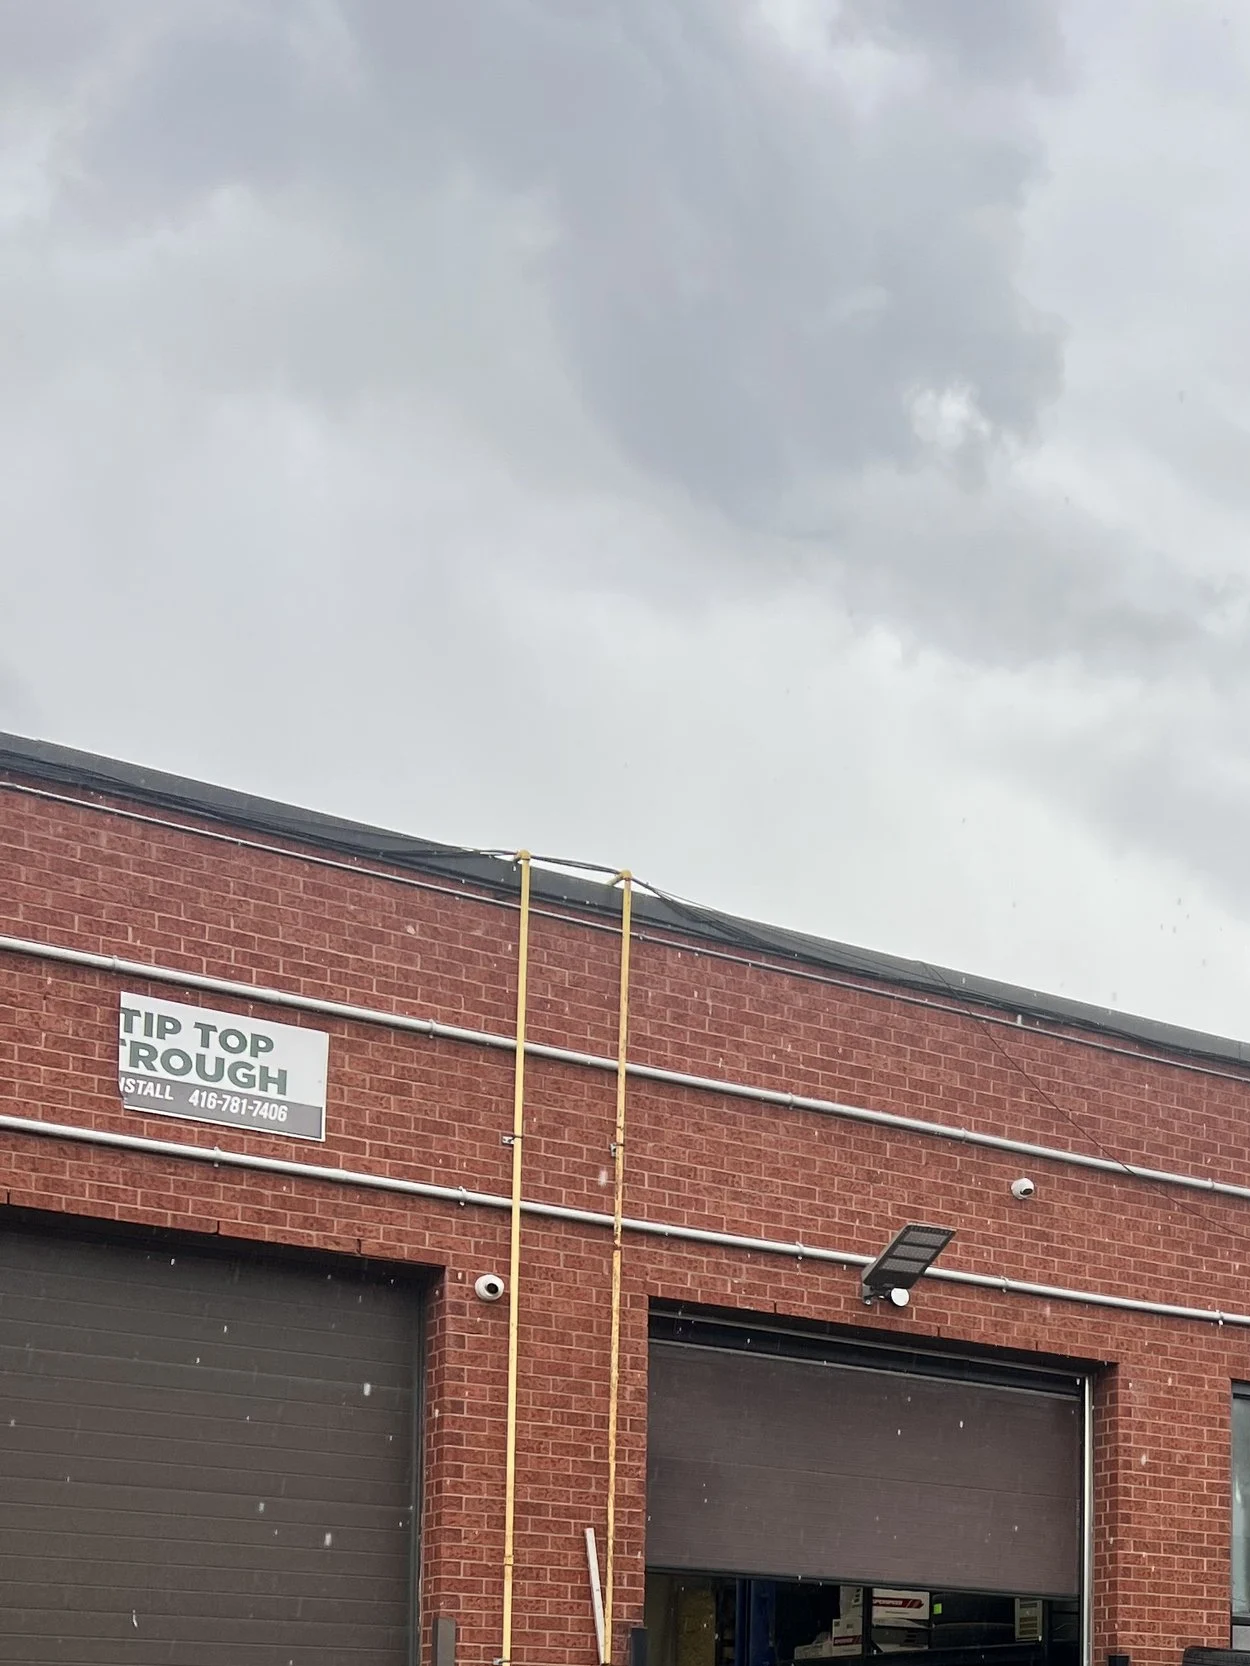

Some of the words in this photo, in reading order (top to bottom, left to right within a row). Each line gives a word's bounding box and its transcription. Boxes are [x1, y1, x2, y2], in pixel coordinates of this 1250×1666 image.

[120, 1007, 182, 1041] TIP
[194, 1021, 275, 1059] TOP
[120, 1038, 288, 1096] ROUGH
[188, 1089, 289, 1122] 416-781-7406
